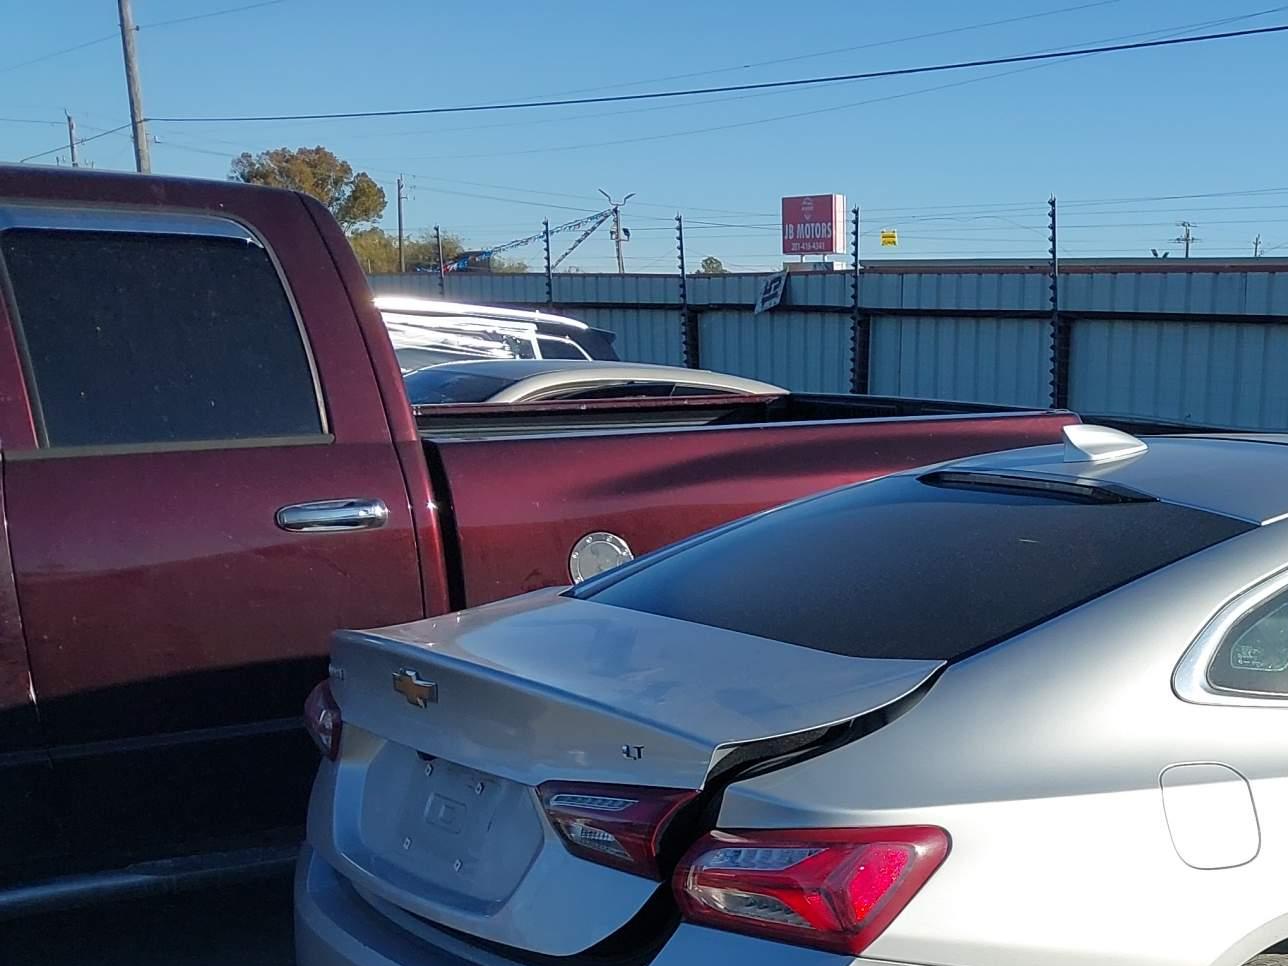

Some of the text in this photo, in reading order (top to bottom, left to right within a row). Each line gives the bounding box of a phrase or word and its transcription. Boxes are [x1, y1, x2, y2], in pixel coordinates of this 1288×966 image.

[784, 222, 832, 240] JB MOTORS
[623, 744, 645, 760] LT
